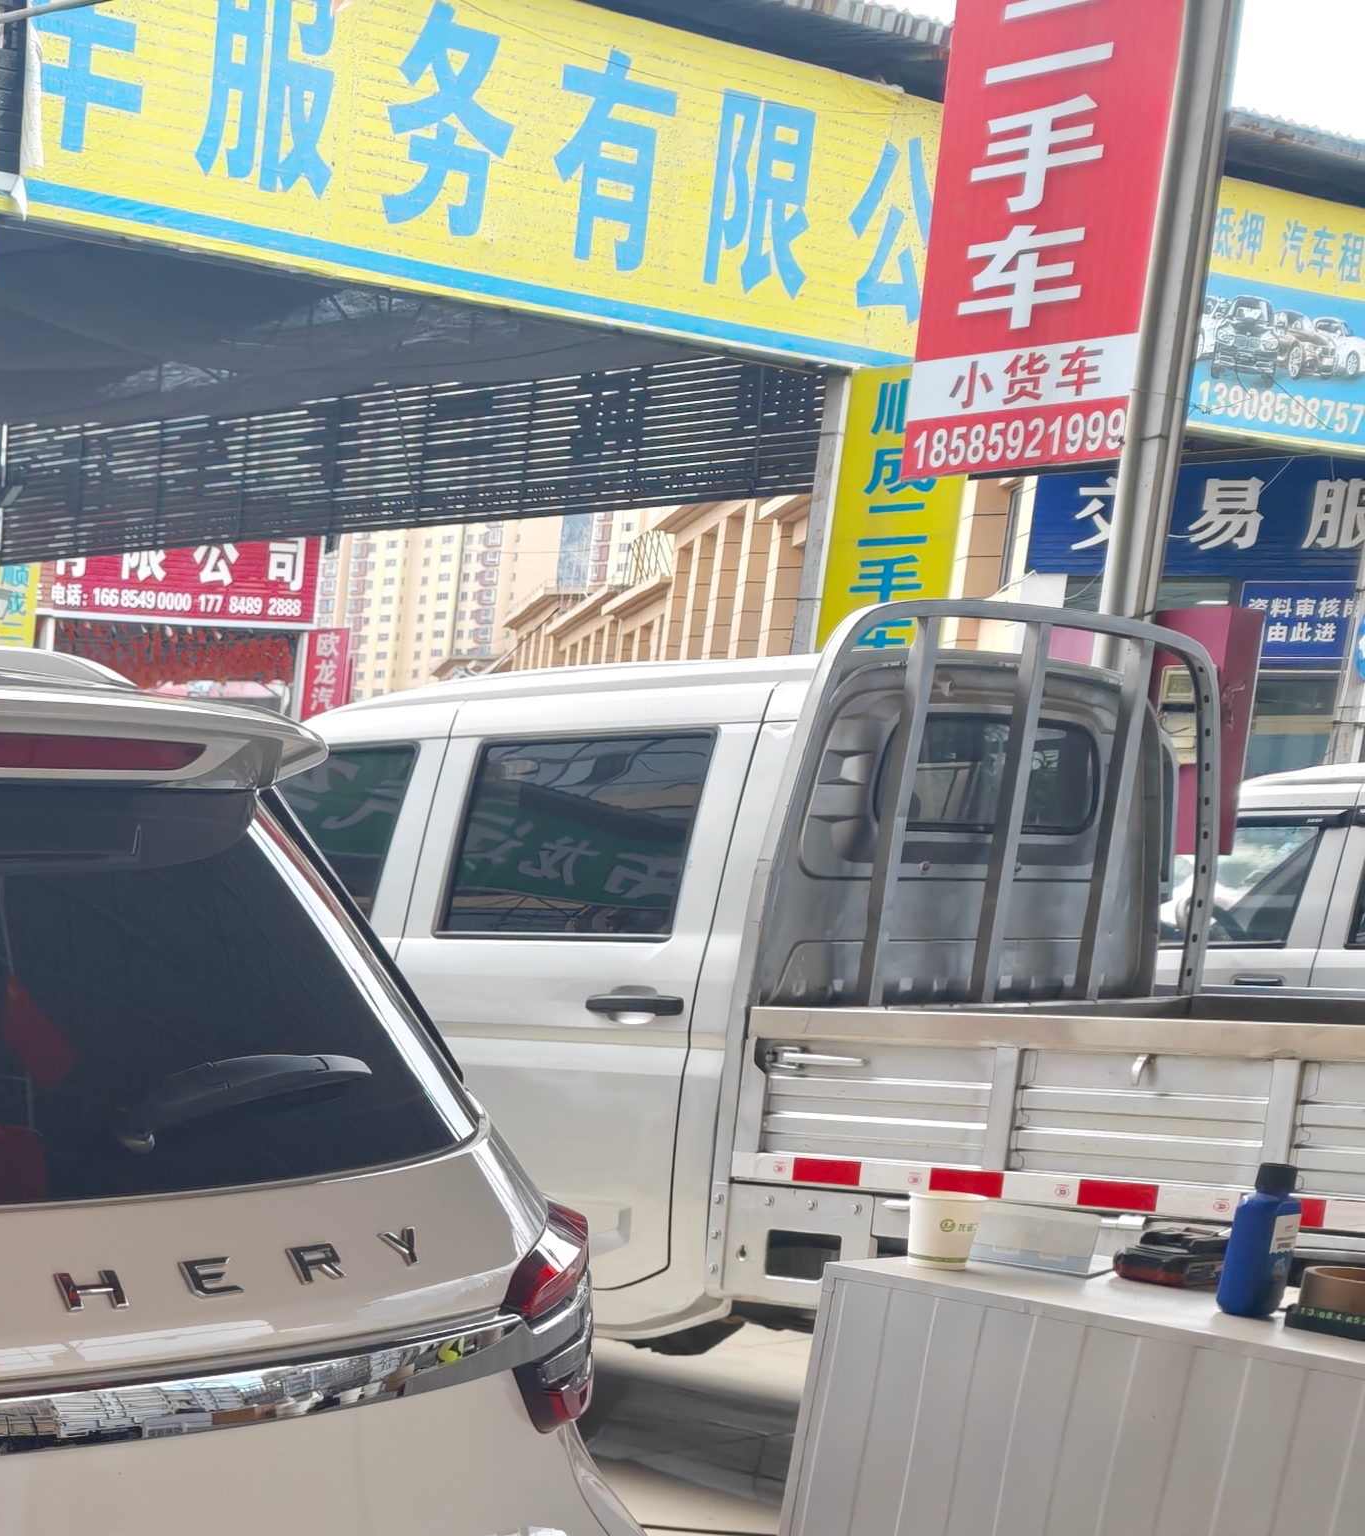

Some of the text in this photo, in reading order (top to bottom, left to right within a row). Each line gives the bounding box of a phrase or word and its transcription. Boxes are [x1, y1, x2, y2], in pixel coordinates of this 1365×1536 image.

[949, 346, 1104, 409] 小货车
[1198, 380, 1365, 436] 13908598757
[913, 407, 1127, 471] 18585921999
[198, 594, 224, 613] 177
[1266, 621, 1337, 643] 由此进
